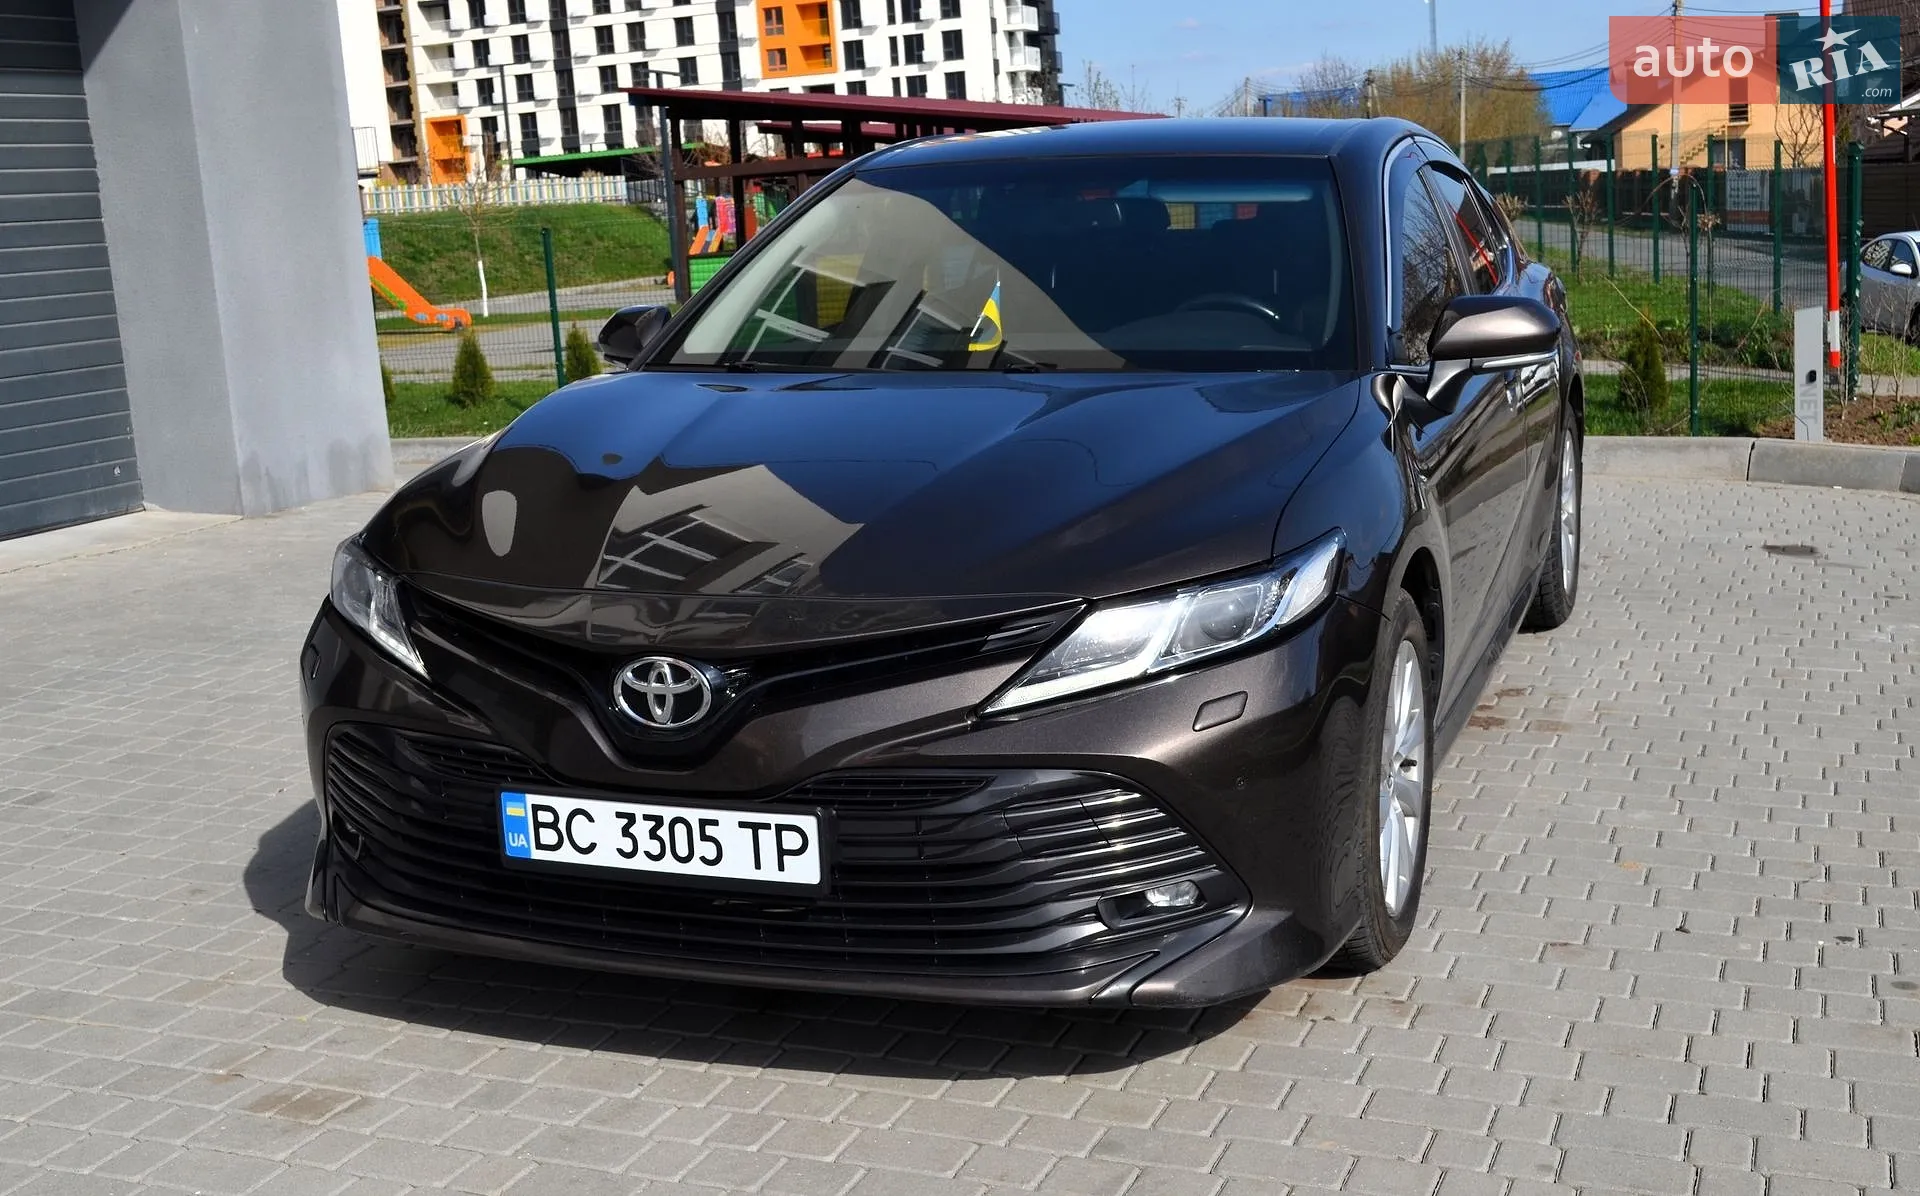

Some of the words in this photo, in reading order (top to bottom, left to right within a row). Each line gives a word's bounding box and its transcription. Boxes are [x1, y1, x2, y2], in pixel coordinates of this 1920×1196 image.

[508, 831, 529, 848] UA
[531, 803, 597, 855] BC
[615, 811, 723, 866] 3305
[738, 821, 809, 872] TP
